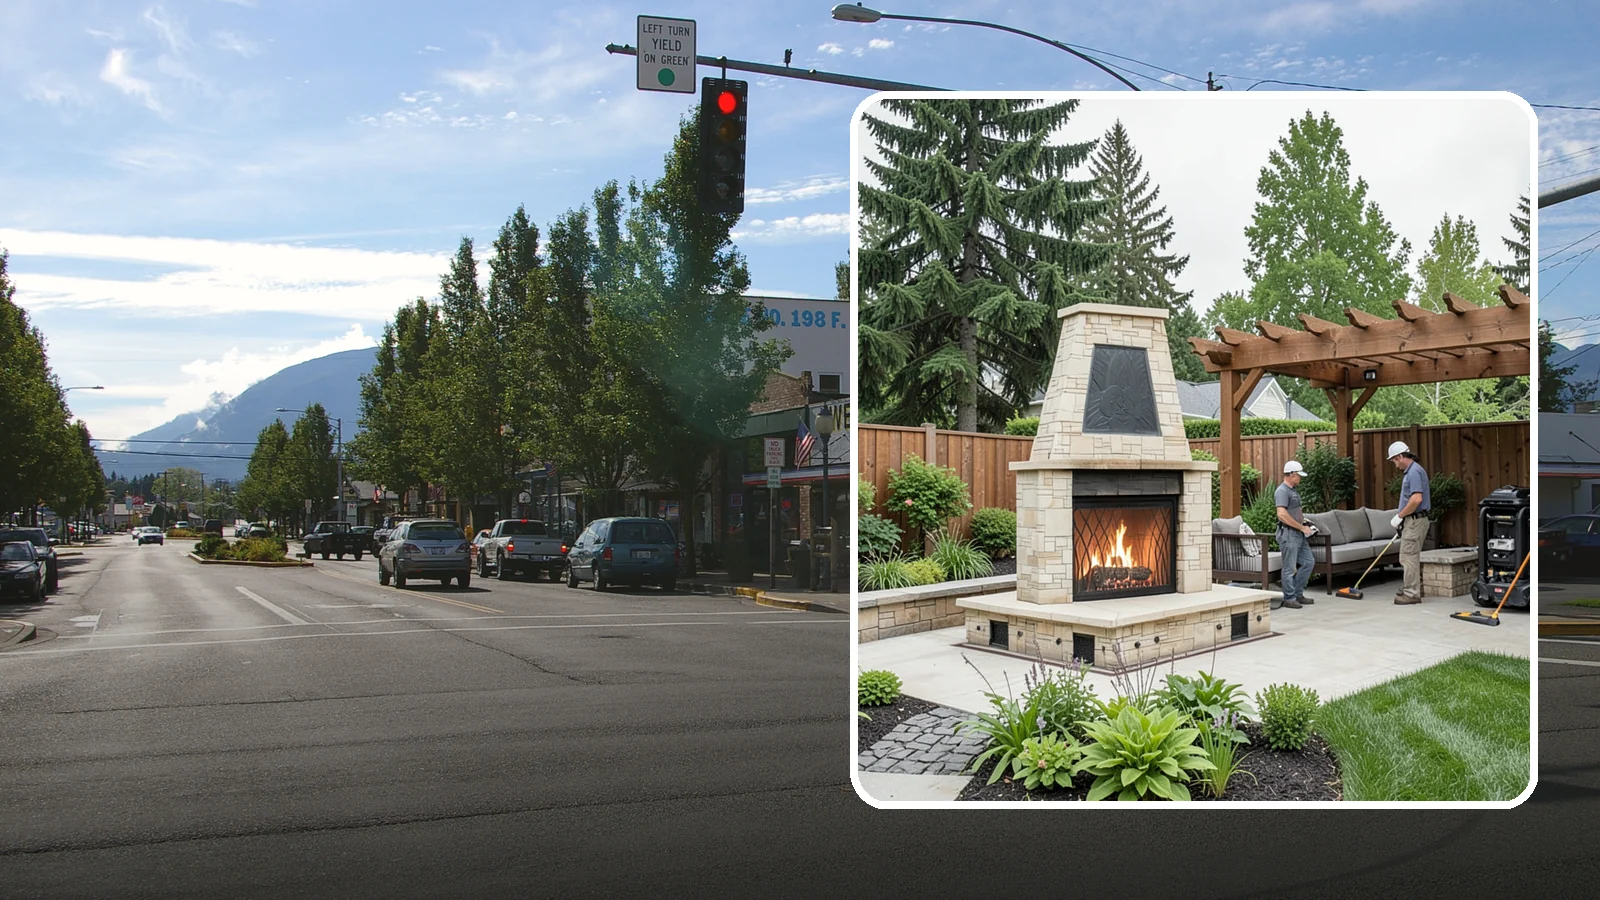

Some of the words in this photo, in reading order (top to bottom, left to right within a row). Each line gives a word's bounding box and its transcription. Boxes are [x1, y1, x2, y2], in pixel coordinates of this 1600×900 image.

[643, 24, 663, 34] LEFT
[668, 26, 690, 36] TURN
[652, 38, 682, 52] YIELD
[644, 53, 656, 64] ON
[661, 55, 689, 66] GREEN
[791, 309, 826, 328] 198
[831, 311, 847, 329] F.
